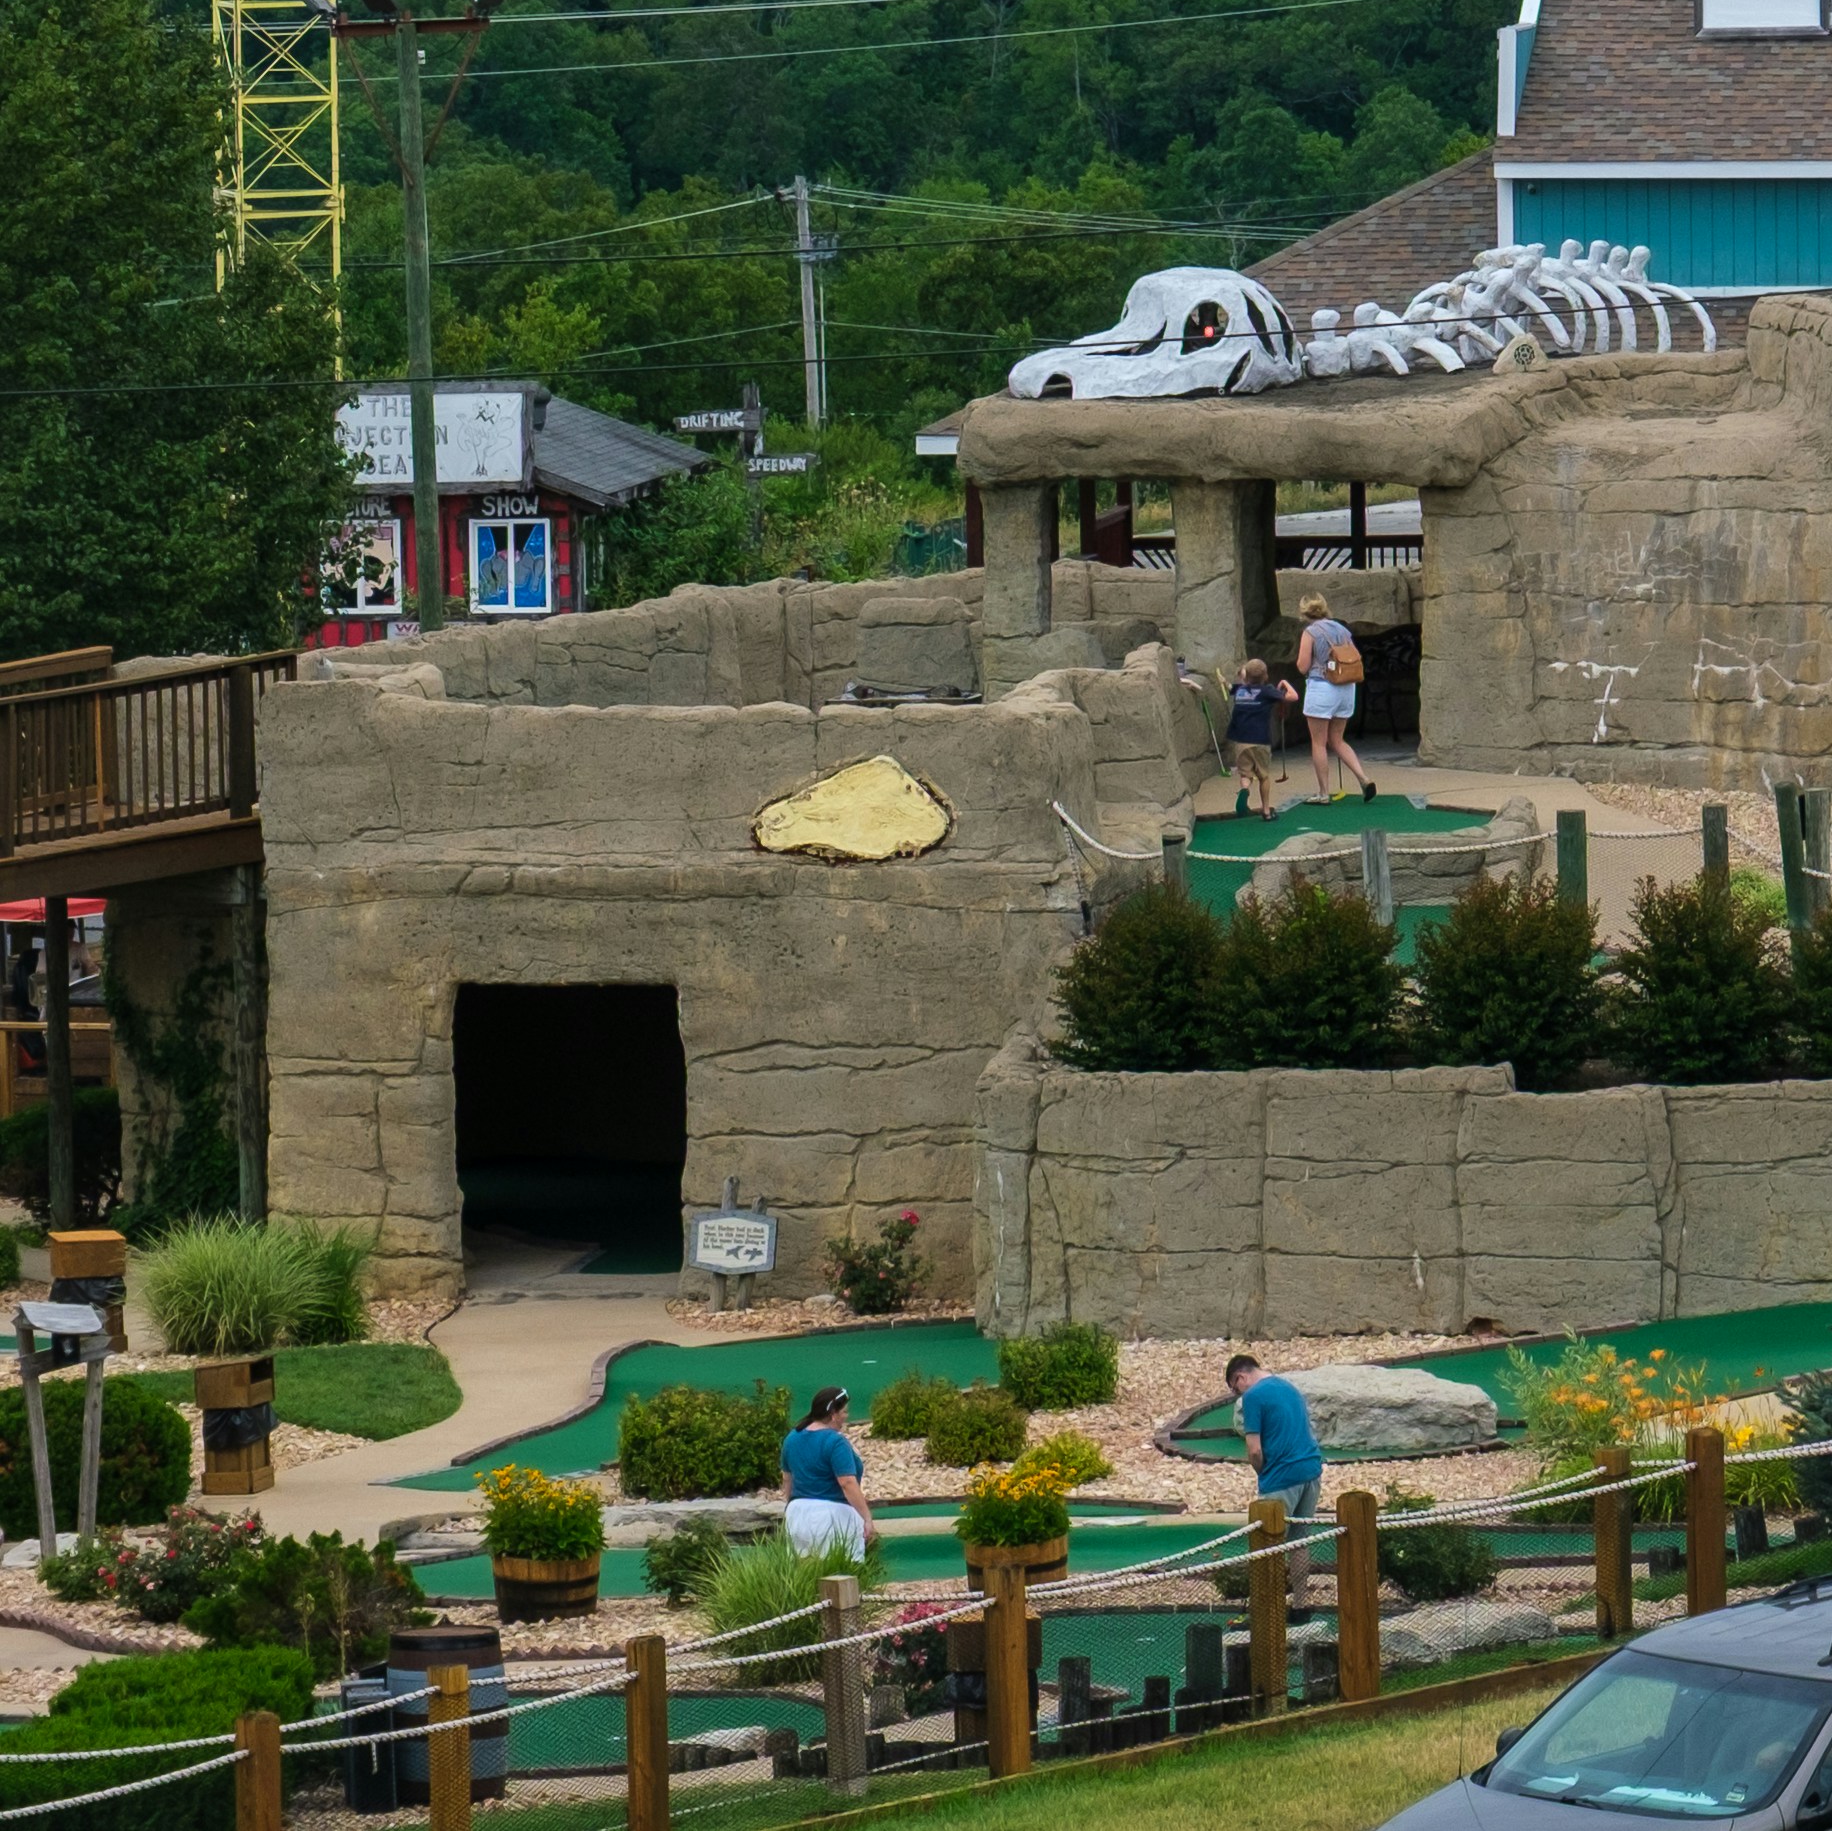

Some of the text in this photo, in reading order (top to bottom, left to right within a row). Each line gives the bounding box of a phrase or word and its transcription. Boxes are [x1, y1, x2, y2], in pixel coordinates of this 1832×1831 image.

[366, 397, 412, 418] THE
[680, 411, 745, 429] DRIFTING
[748, 457, 807, 472] SPEEDWAY
[481, 495, 539, 517] SHOW
